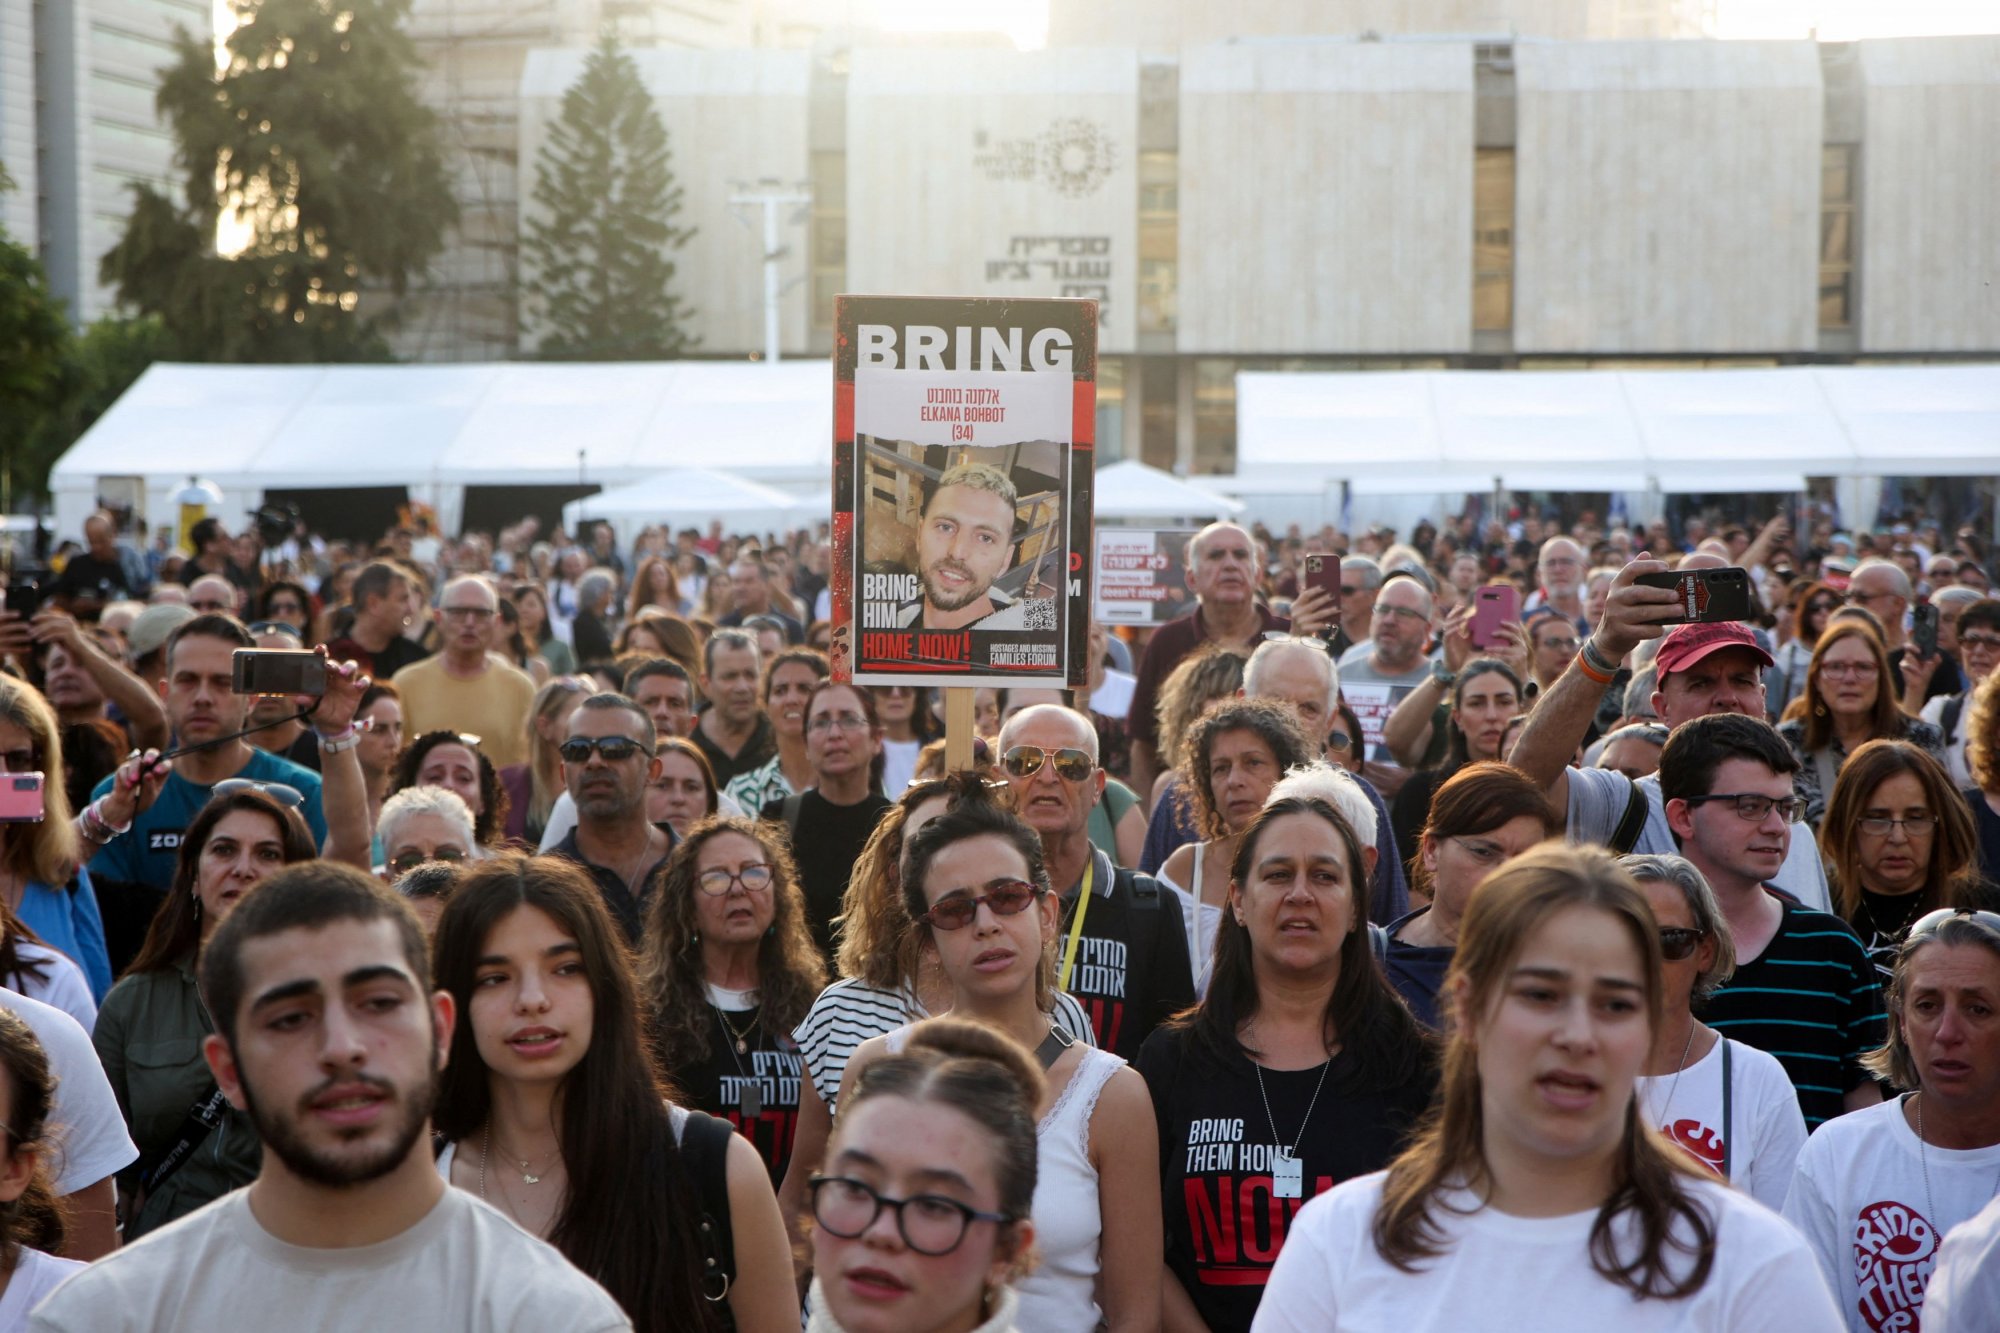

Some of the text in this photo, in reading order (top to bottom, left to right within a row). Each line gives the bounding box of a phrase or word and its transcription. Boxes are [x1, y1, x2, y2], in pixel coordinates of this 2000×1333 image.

[857, 324, 1073, 372] BRING
[927, 388, 1000, 405] אלקנה בוחבוט
[921, 406, 1005, 423] ELKANA BOHBOT
[952, 424, 974, 442] (34)
[863, 573, 917, 601] BRING
[863, 603, 897, 629] HIM
[863, 632, 971, 661] HOME NOW!
[990, 643, 1056, 654] HOSTAGES AND MISSING
[990, 652, 1056, 666] FAMILIES FORUM
[1060, 934, 1127, 969] מחזיר
[1081, 964, 1126, 998] אותם
[1187, 1118, 1244, 1145] BRING
[1186, 1144, 1234, 1173] THEM
